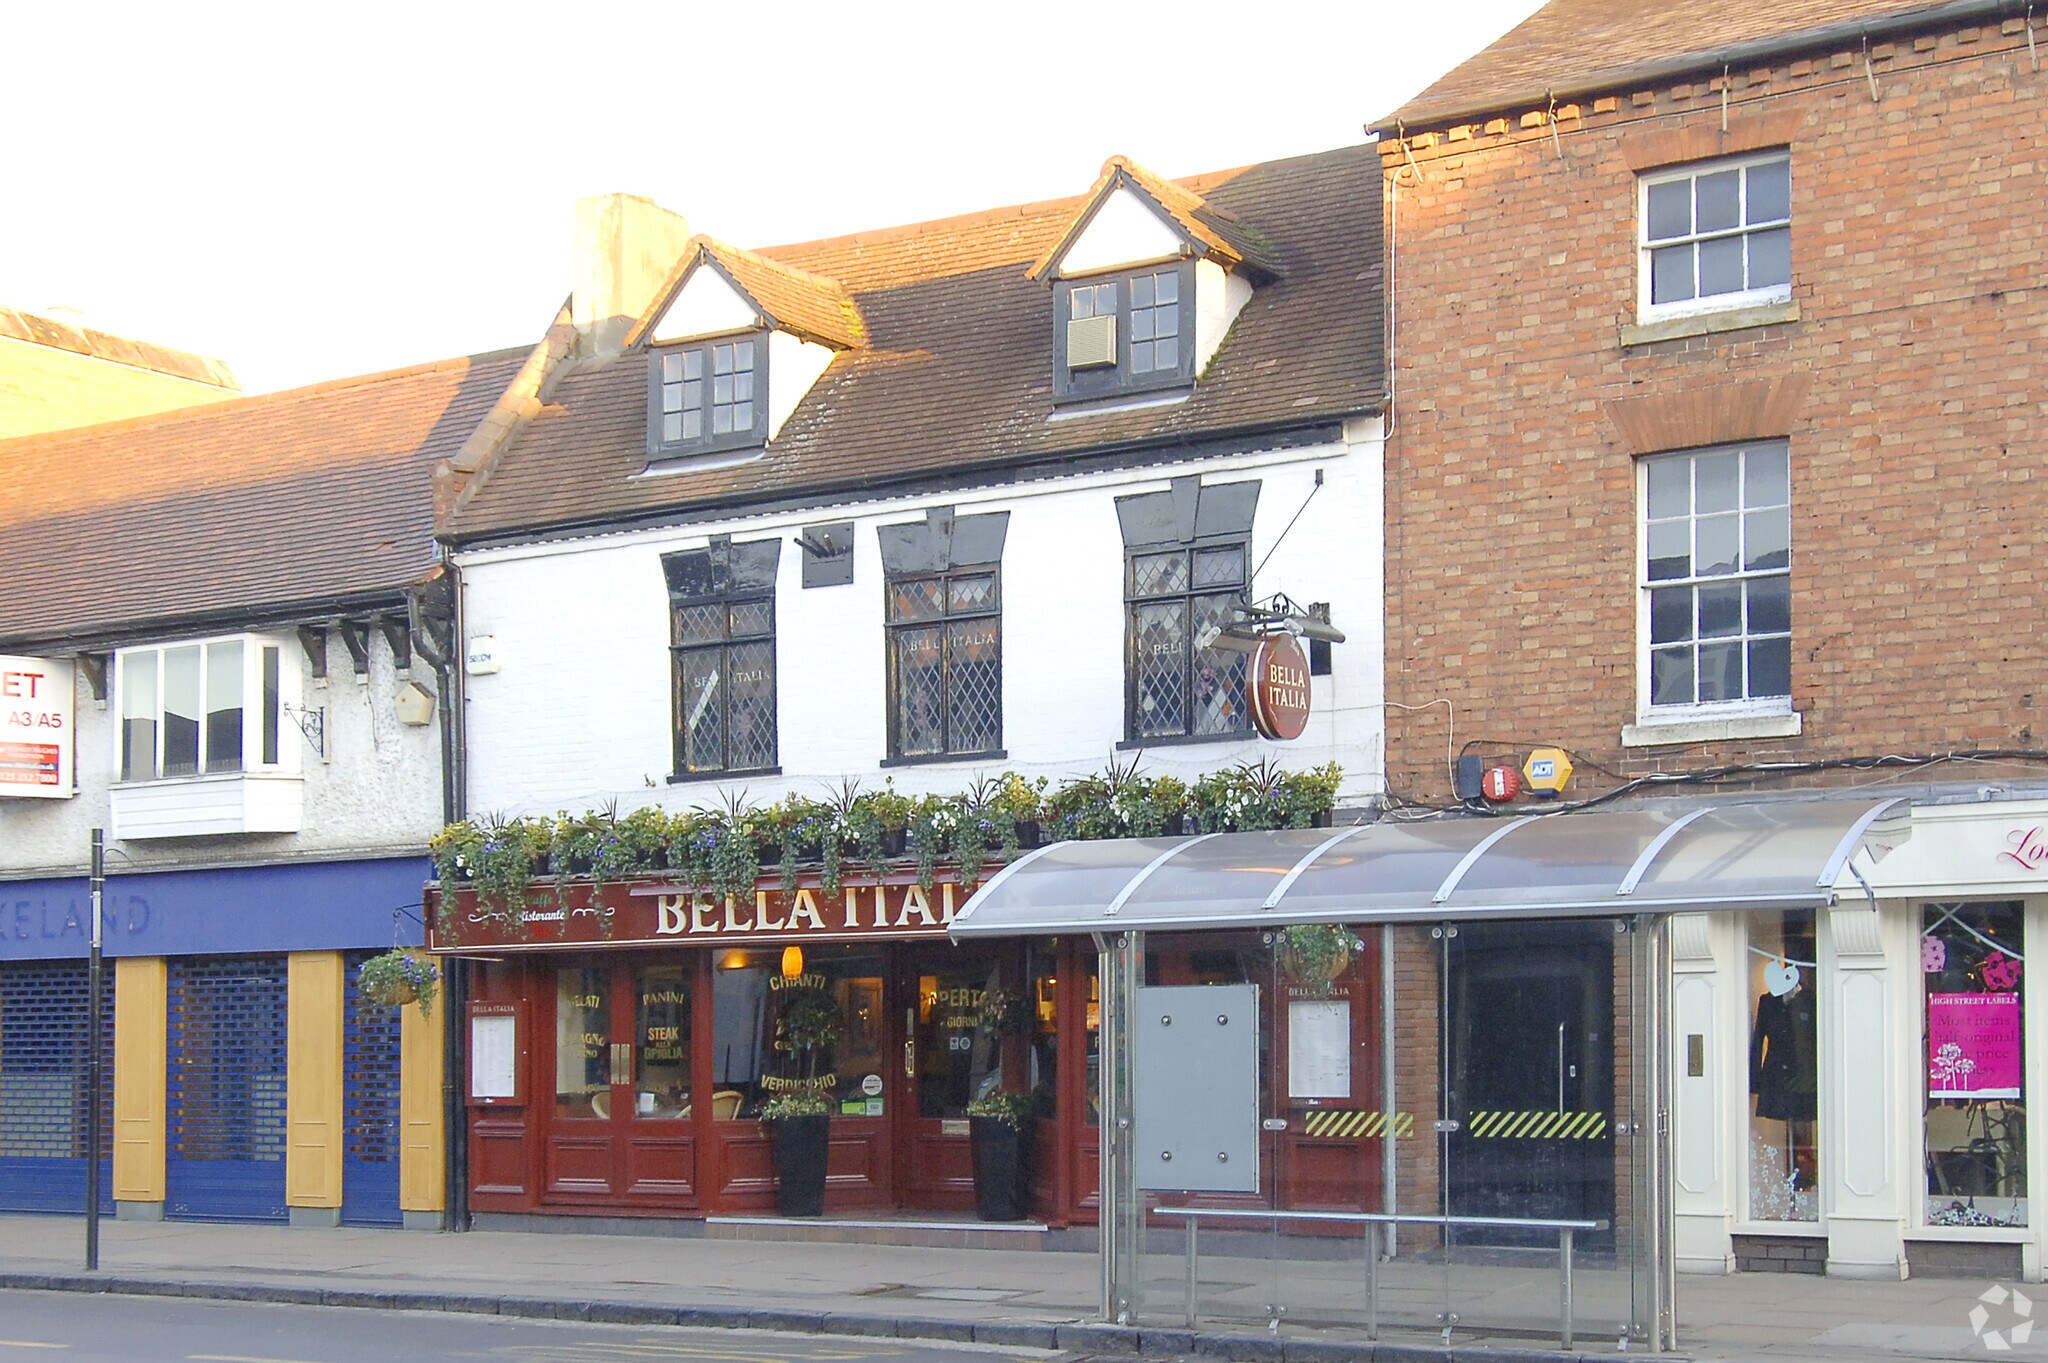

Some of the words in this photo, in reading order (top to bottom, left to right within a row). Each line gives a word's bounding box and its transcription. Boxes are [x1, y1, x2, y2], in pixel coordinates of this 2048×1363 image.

[910, 640, 940, 651] BELL
[1153, 642, 1184, 655] BELL
[1270, 664, 1305, 688] BELLA
[1269, 686, 1307, 710] ITALIA
[8, 711, 63, 728] A3/A5
[1532, 763, 1554, 777] ADT
[1997, 826, 2048, 871] Lo
[656, 887, 826, 934] BELLA
[769, 973, 826, 991] CHIANTI
[642, 991, 685, 1006] PANINI
[1931, 997, 1952, 1005] HIGH
[1954, 997, 1985, 1005] STREET
[1986, 996, 2017, 1005] LABELS
[472, 1005, 492, 1013] BELLA
[493, 1004, 515, 1012] ITALIA
[1975, 1013, 2010, 1026] items
[648, 1027, 679, 1041] STEAK
[1975, 1047, 2009, 1063] price
